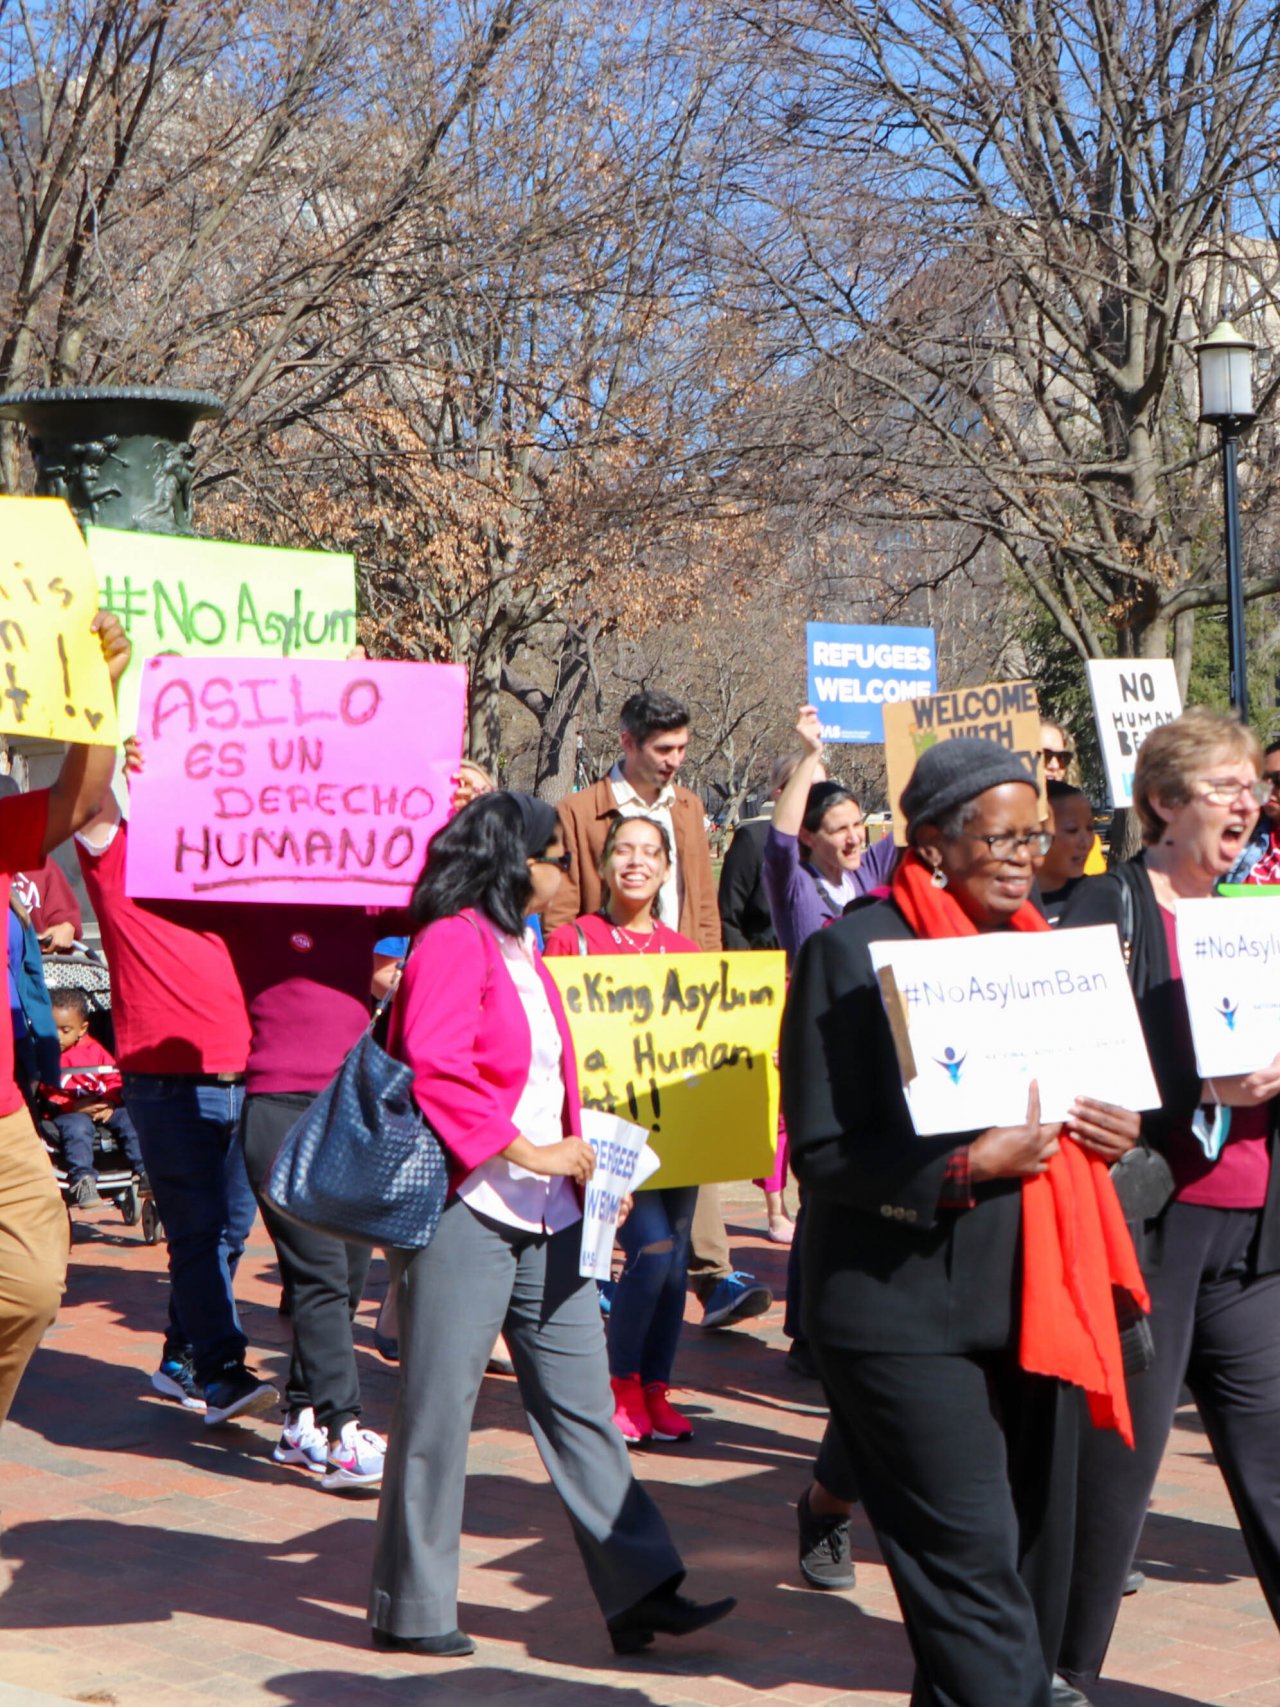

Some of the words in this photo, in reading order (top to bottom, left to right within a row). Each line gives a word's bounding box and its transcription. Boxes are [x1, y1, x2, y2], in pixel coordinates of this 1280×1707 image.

[813, 641, 931, 671] REFUGEES
[814, 678, 932, 703] WELCOME
[910, 680, 1041, 730] WELCOME
[1119, 672, 1155, 702] NO
[151, 675, 382, 741] ASILO
[1112, 711, 1174, 730] HUMAN
[184, 742, 247, 781] ES
[269, 737, 325, 773] UN
[214, 784, 435, 821] DERECHO
[174, 826, 415, 874] HUMANO
[661, 960, 774, 1031] Asylum
[903, 969, 1108, 1009] #NoAsylumBan
[584, 1050, 607, 1071] a
[633, 1032, 754, 1076] Human
